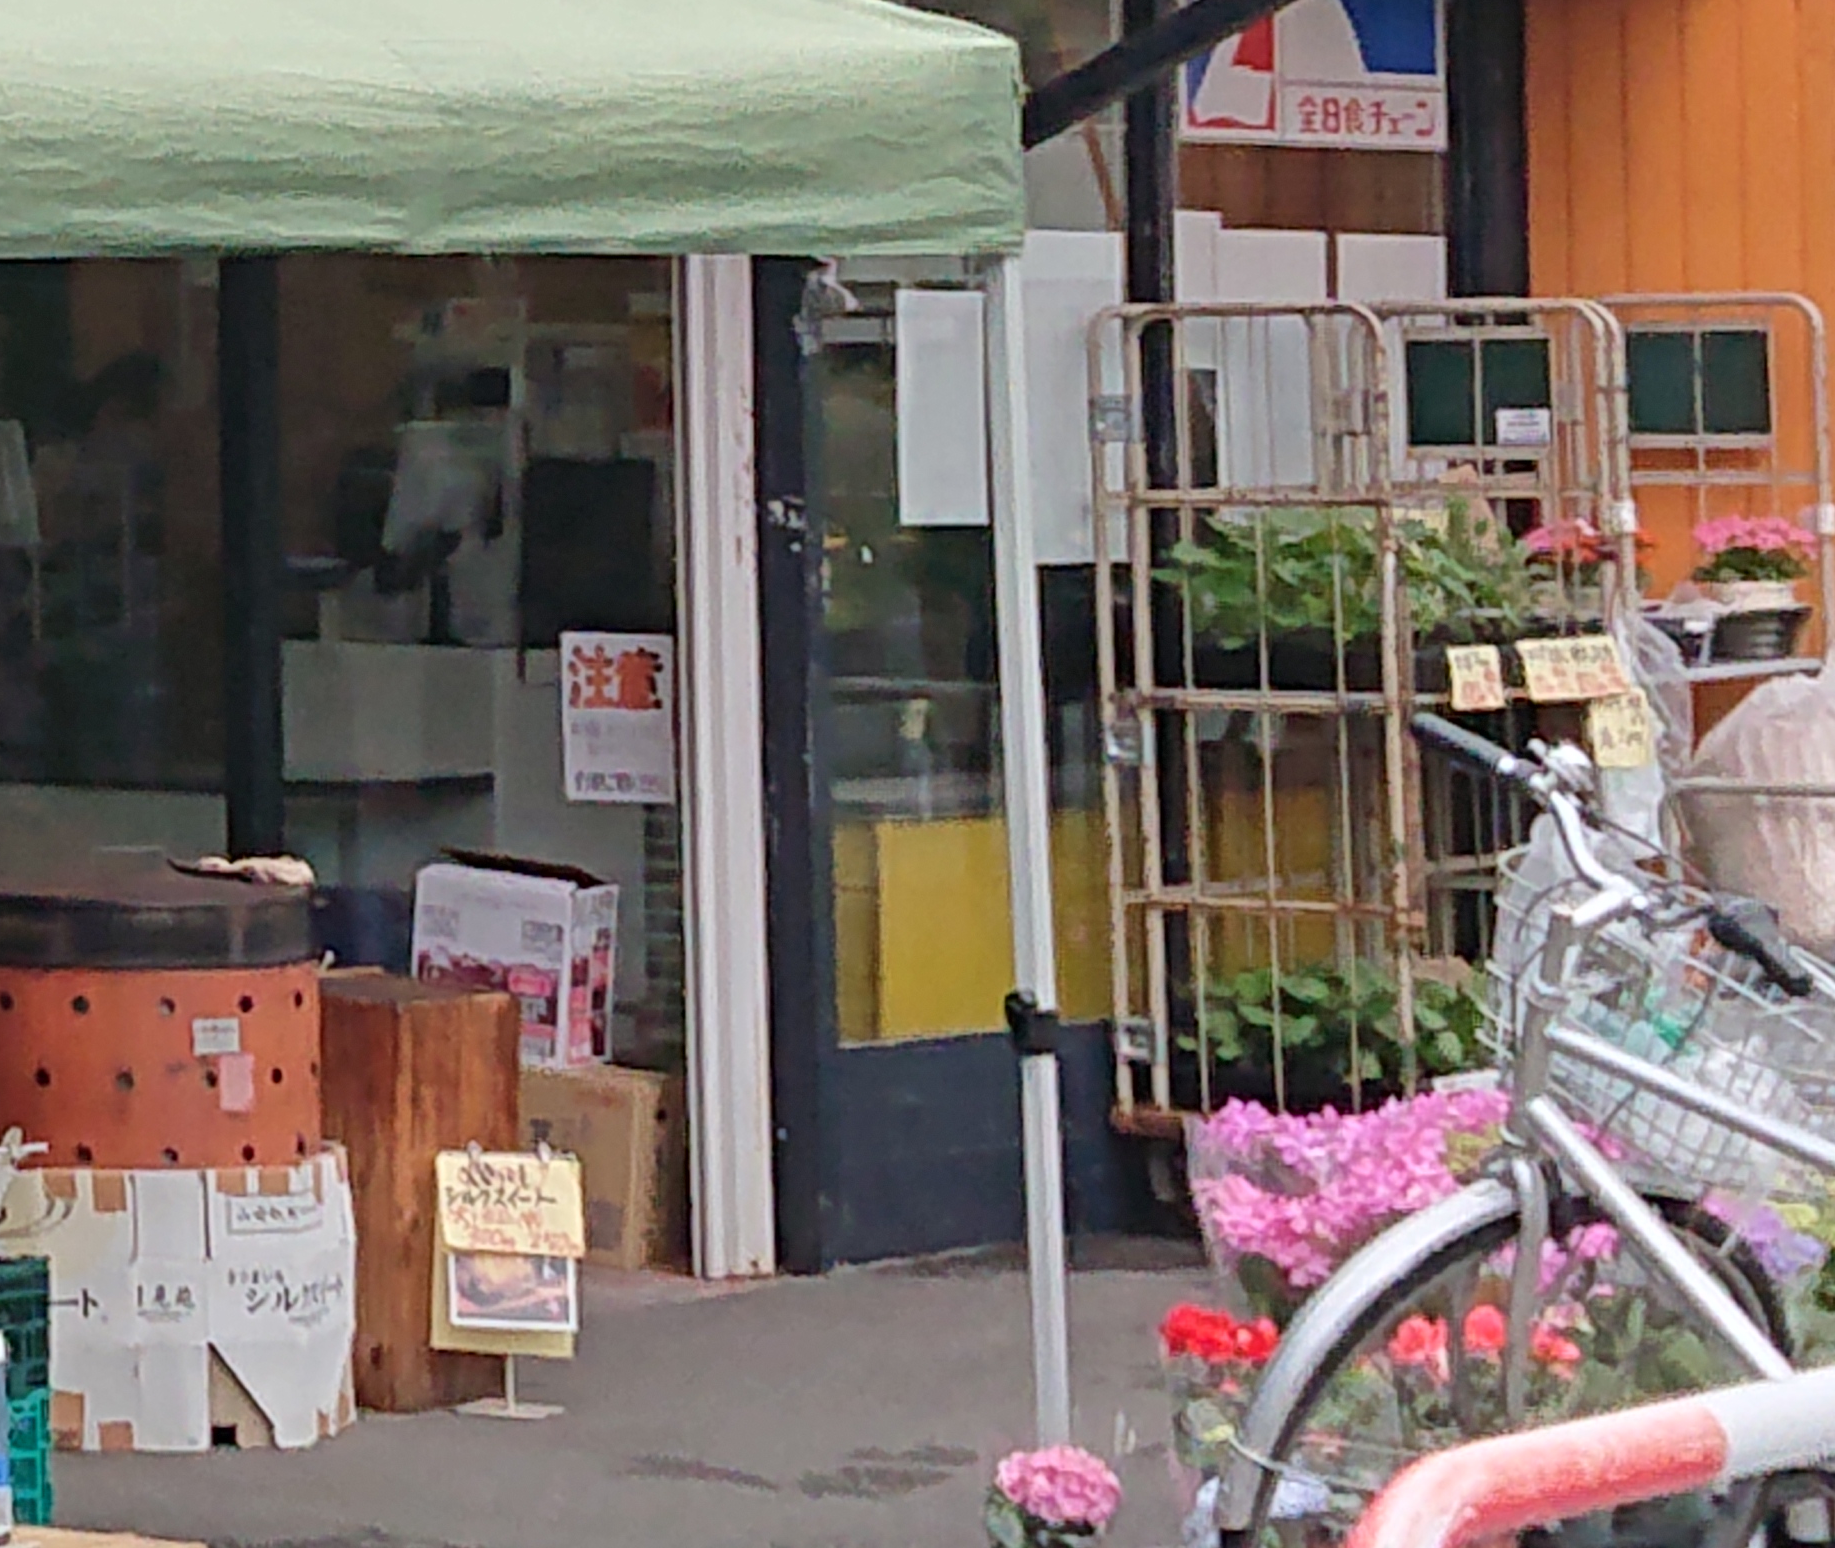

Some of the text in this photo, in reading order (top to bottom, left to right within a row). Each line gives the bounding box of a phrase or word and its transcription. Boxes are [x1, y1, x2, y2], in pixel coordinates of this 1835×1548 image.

[1297, 94, 1436, 138] 全日食チェーン
